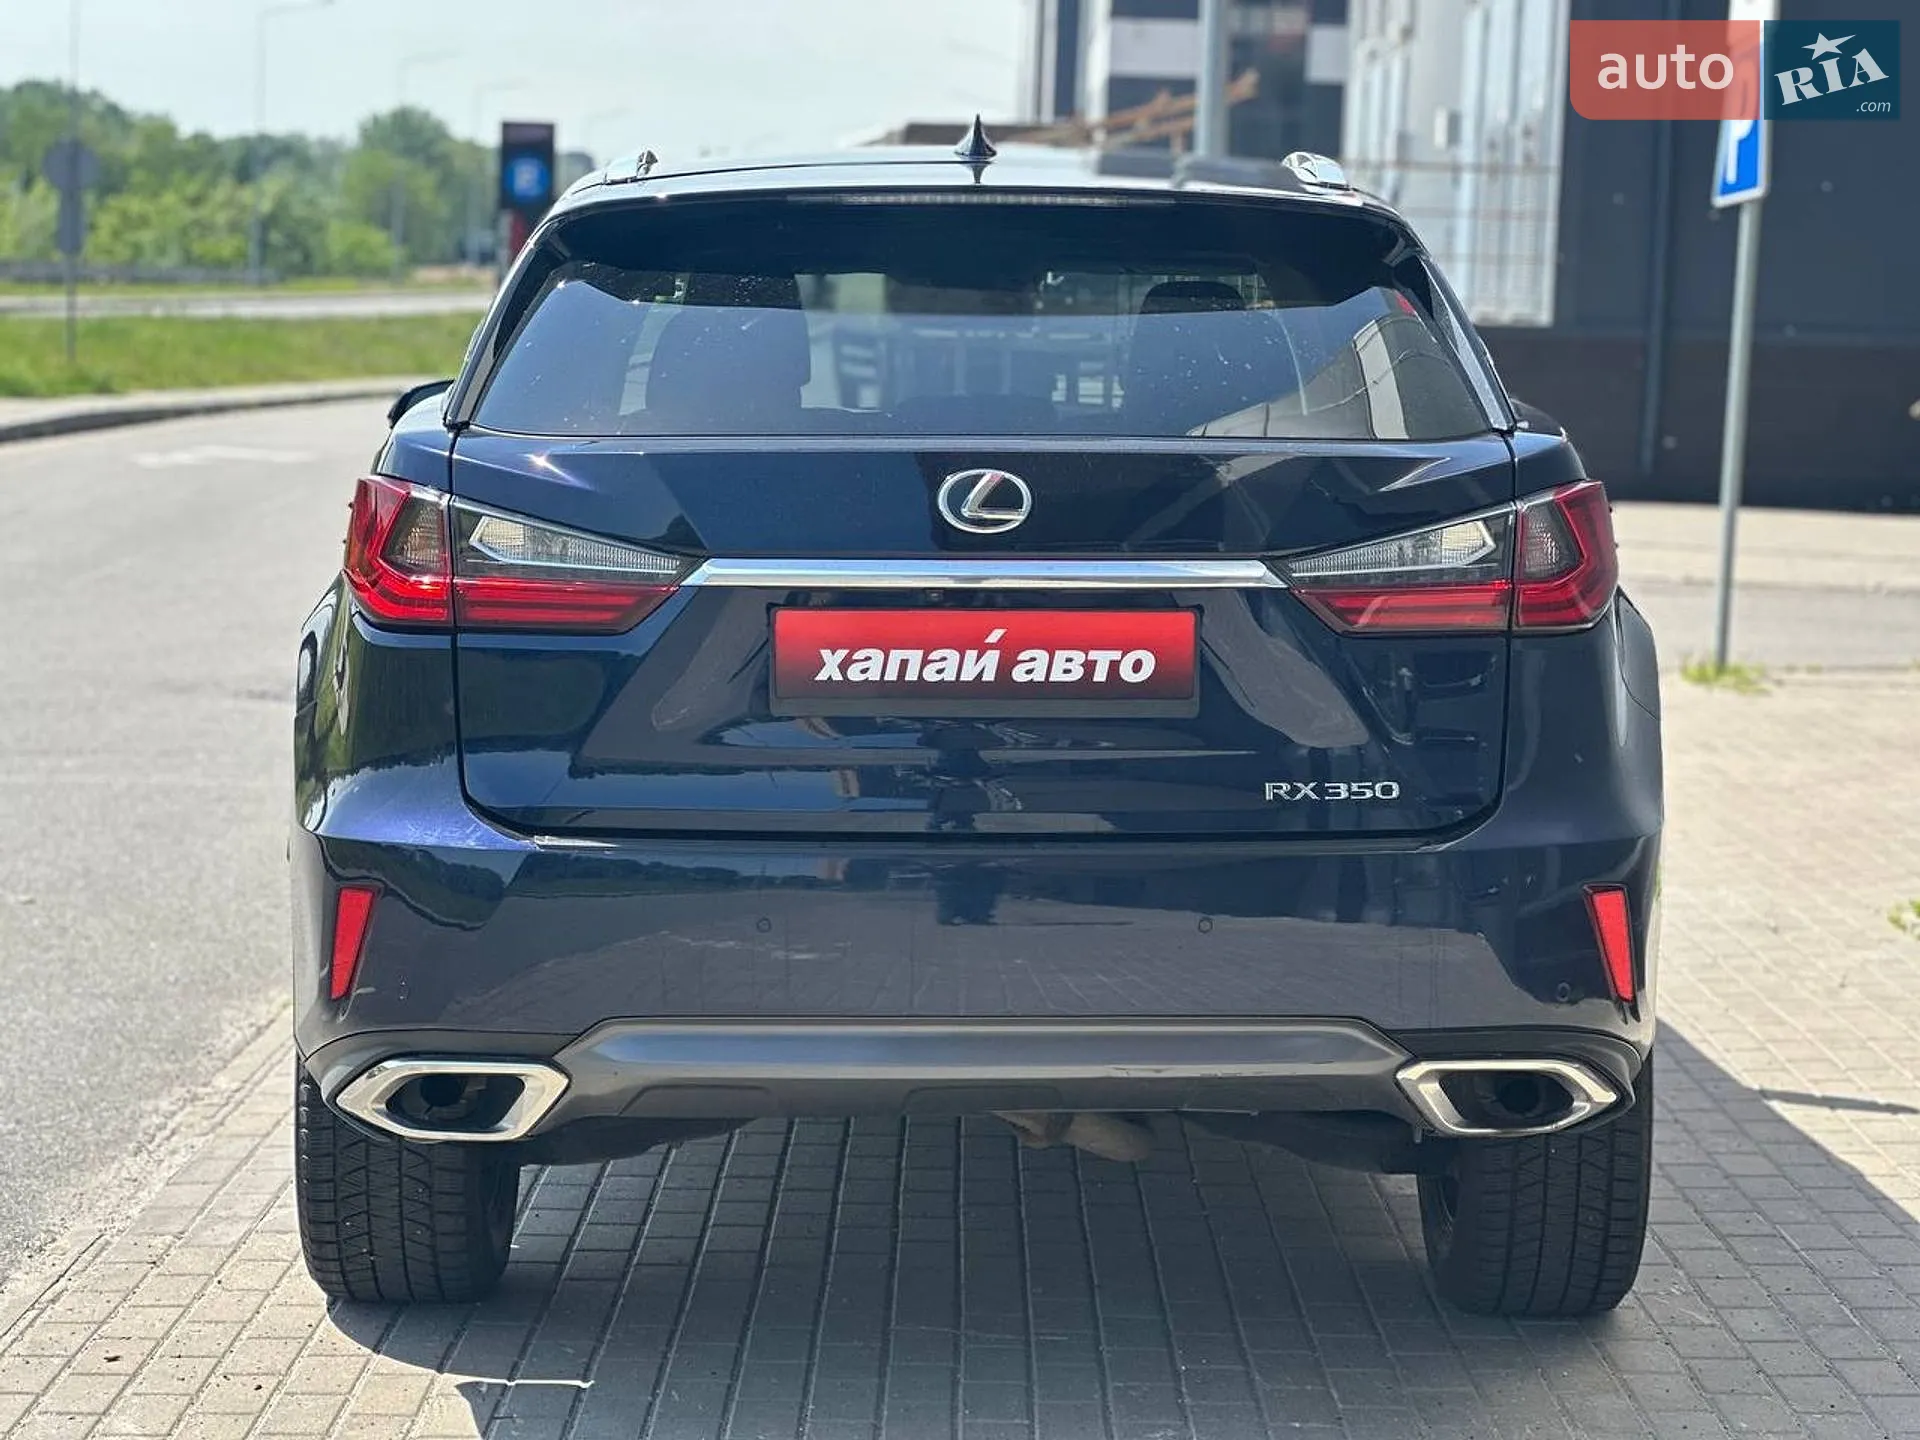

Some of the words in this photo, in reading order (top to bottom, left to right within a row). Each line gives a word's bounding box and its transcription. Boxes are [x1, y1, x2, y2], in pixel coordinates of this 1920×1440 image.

[1011, 649, 1156, 682] авто
[1265, 782, 1321, 800] RX
[1325, 781, 1400, 800] 350
